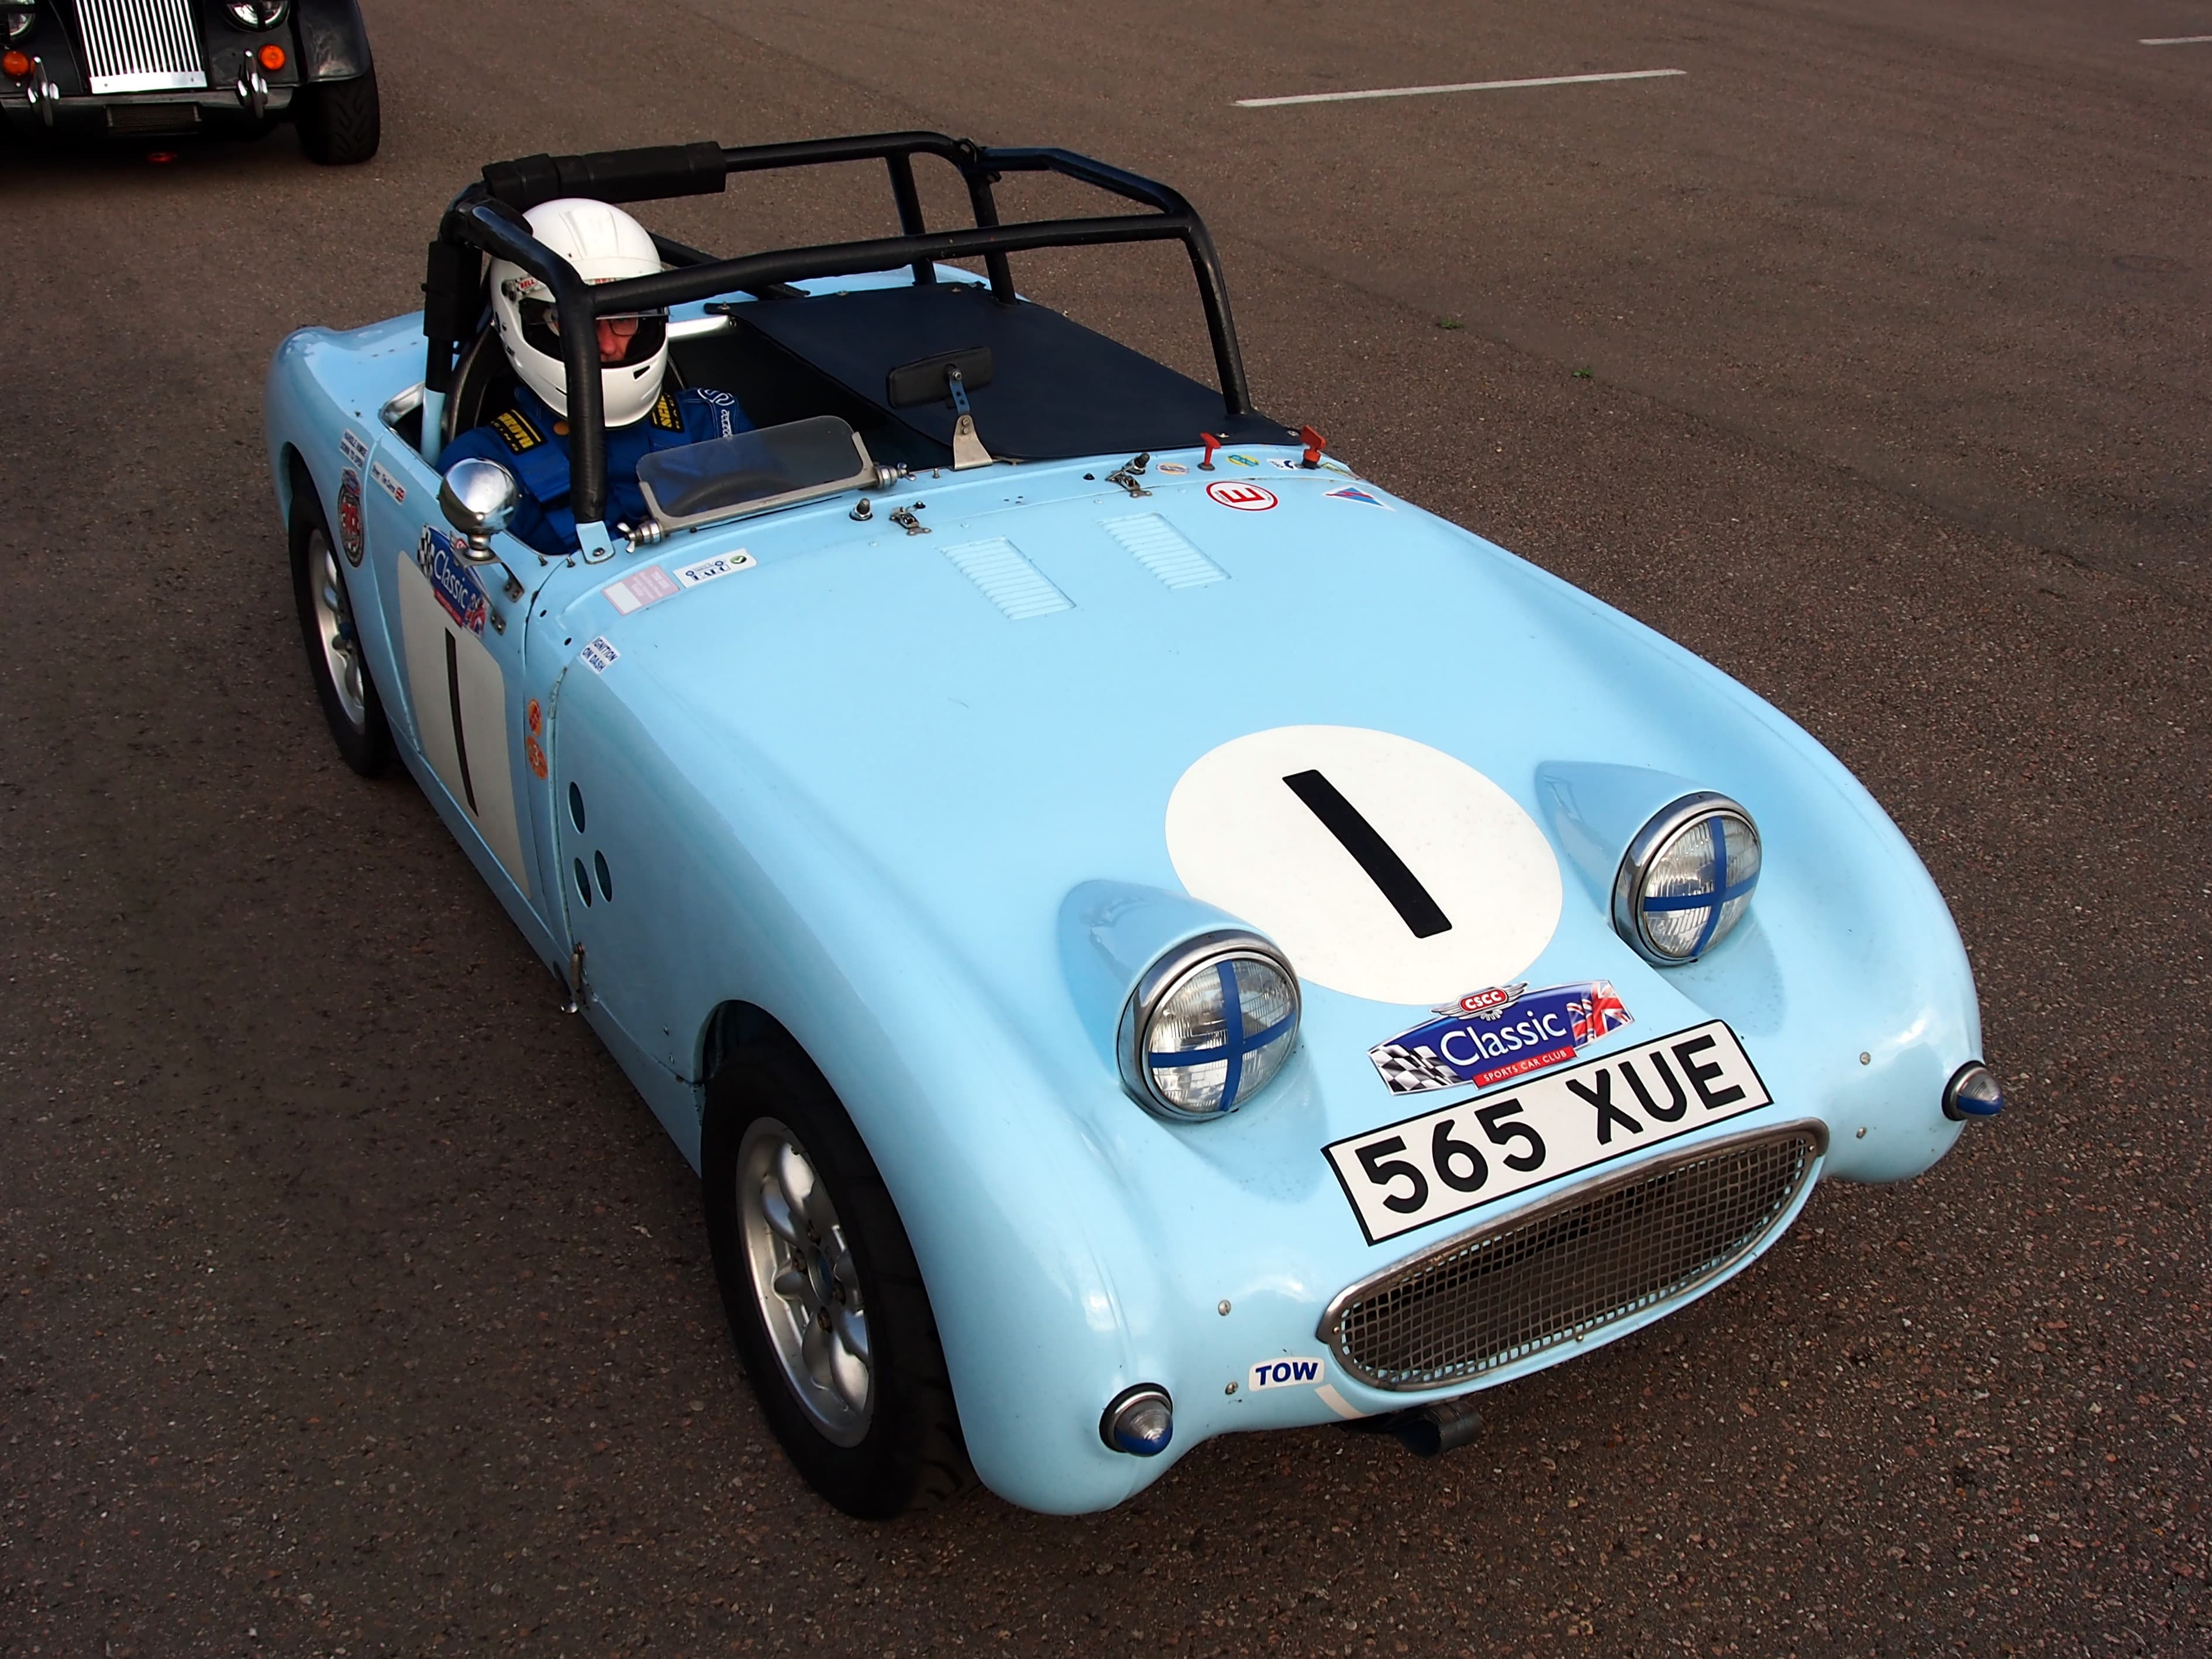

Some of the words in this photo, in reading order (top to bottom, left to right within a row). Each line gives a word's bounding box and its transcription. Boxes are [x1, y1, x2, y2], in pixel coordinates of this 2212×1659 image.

[521, 278, 535, 288] BELL
[721, 409, 733, 438] parco
[1218, 487, 1265, 503] E
[435, 550, 468, 609] Classic
[583, 648, 594, 659] ON
[590, 654, 606, 672] DASH
[592, 637, 618, 662] IGNITION
[446, 627, 478, 817] 1
[1282, 769, 1452, 938] 1
[1465, 991, 1502, 1009] CSCC
[1441, 1011, 1567, 1066] Classic
[1484, 1066, 1518, 1082] SPORTS
[1521, 1059, 1541, 1070] CAR
[1542, 1050, 1567, 1062] CLUB
[1355, 1099, 1546, 1214] 565
[1566, 1035, 1746, 1145] XUE
[1256, 1362, 1318, 1385] TOW
